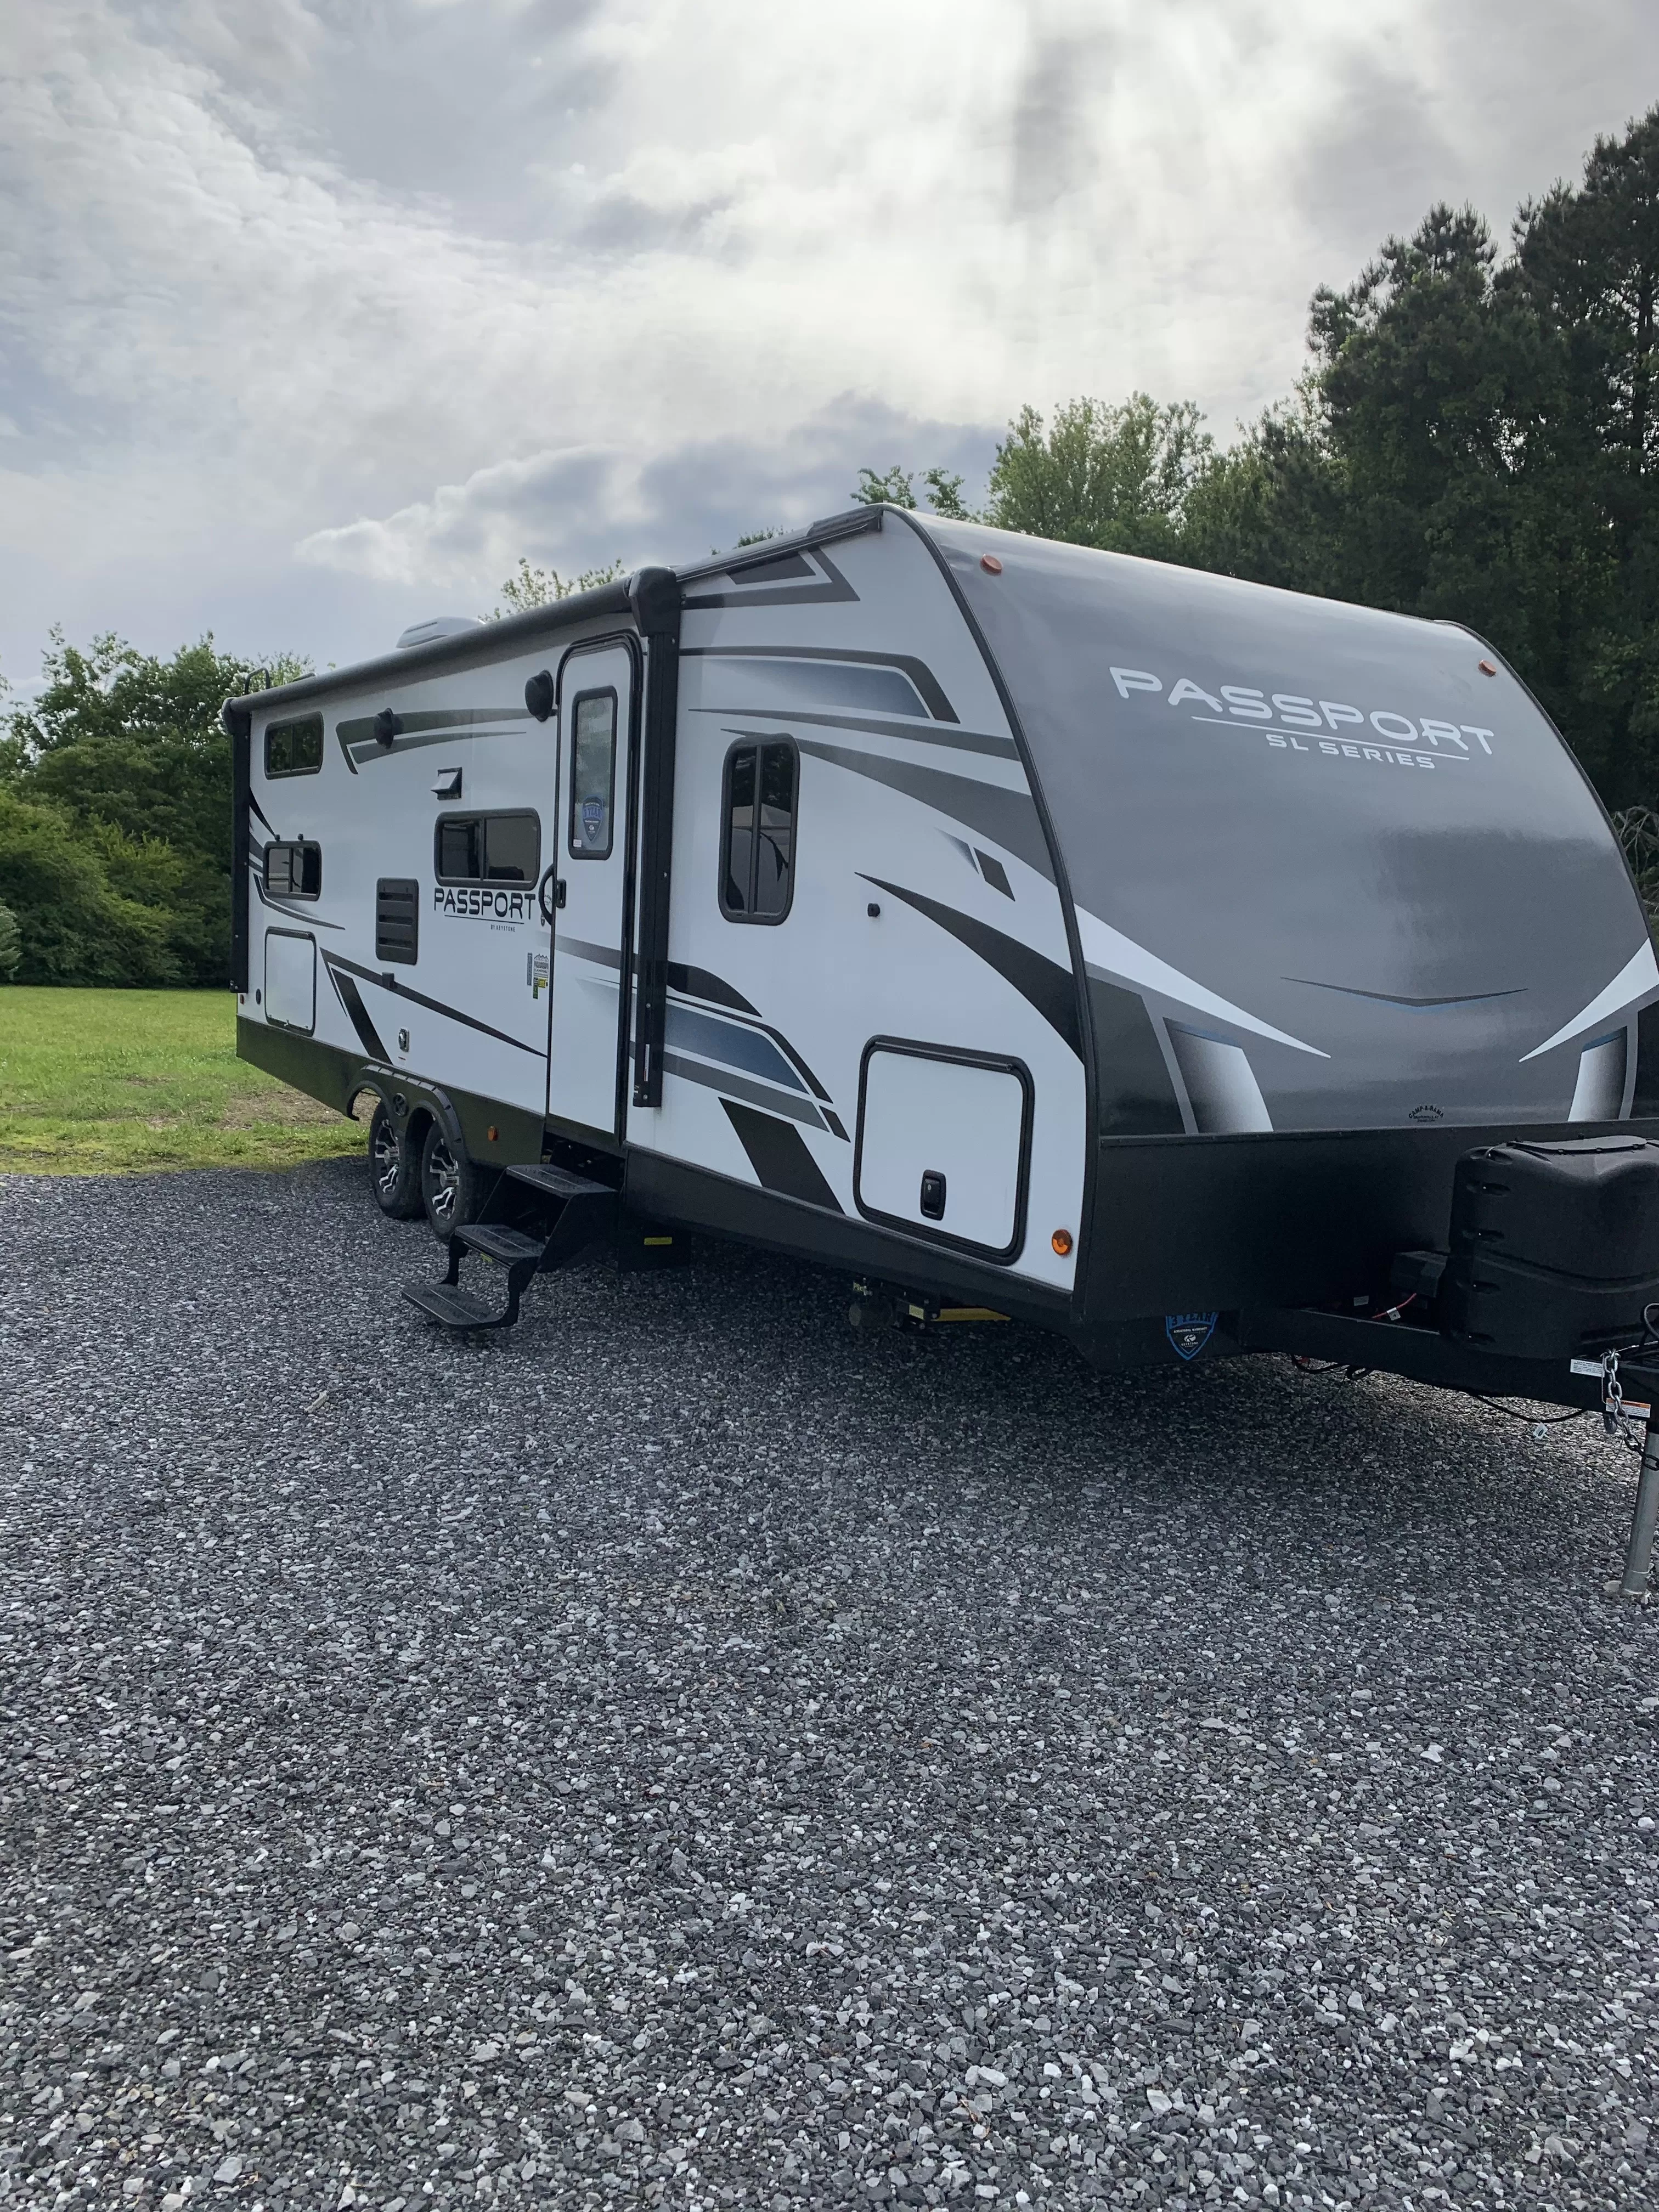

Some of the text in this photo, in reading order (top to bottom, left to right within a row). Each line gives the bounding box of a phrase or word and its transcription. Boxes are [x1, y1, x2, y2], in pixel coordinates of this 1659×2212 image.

[1109, 667, 1494, 755] PASSPORT
[1266, 733, 1435, 769] SL SERIES
[434, 888, 535, 919] PASSPORT
